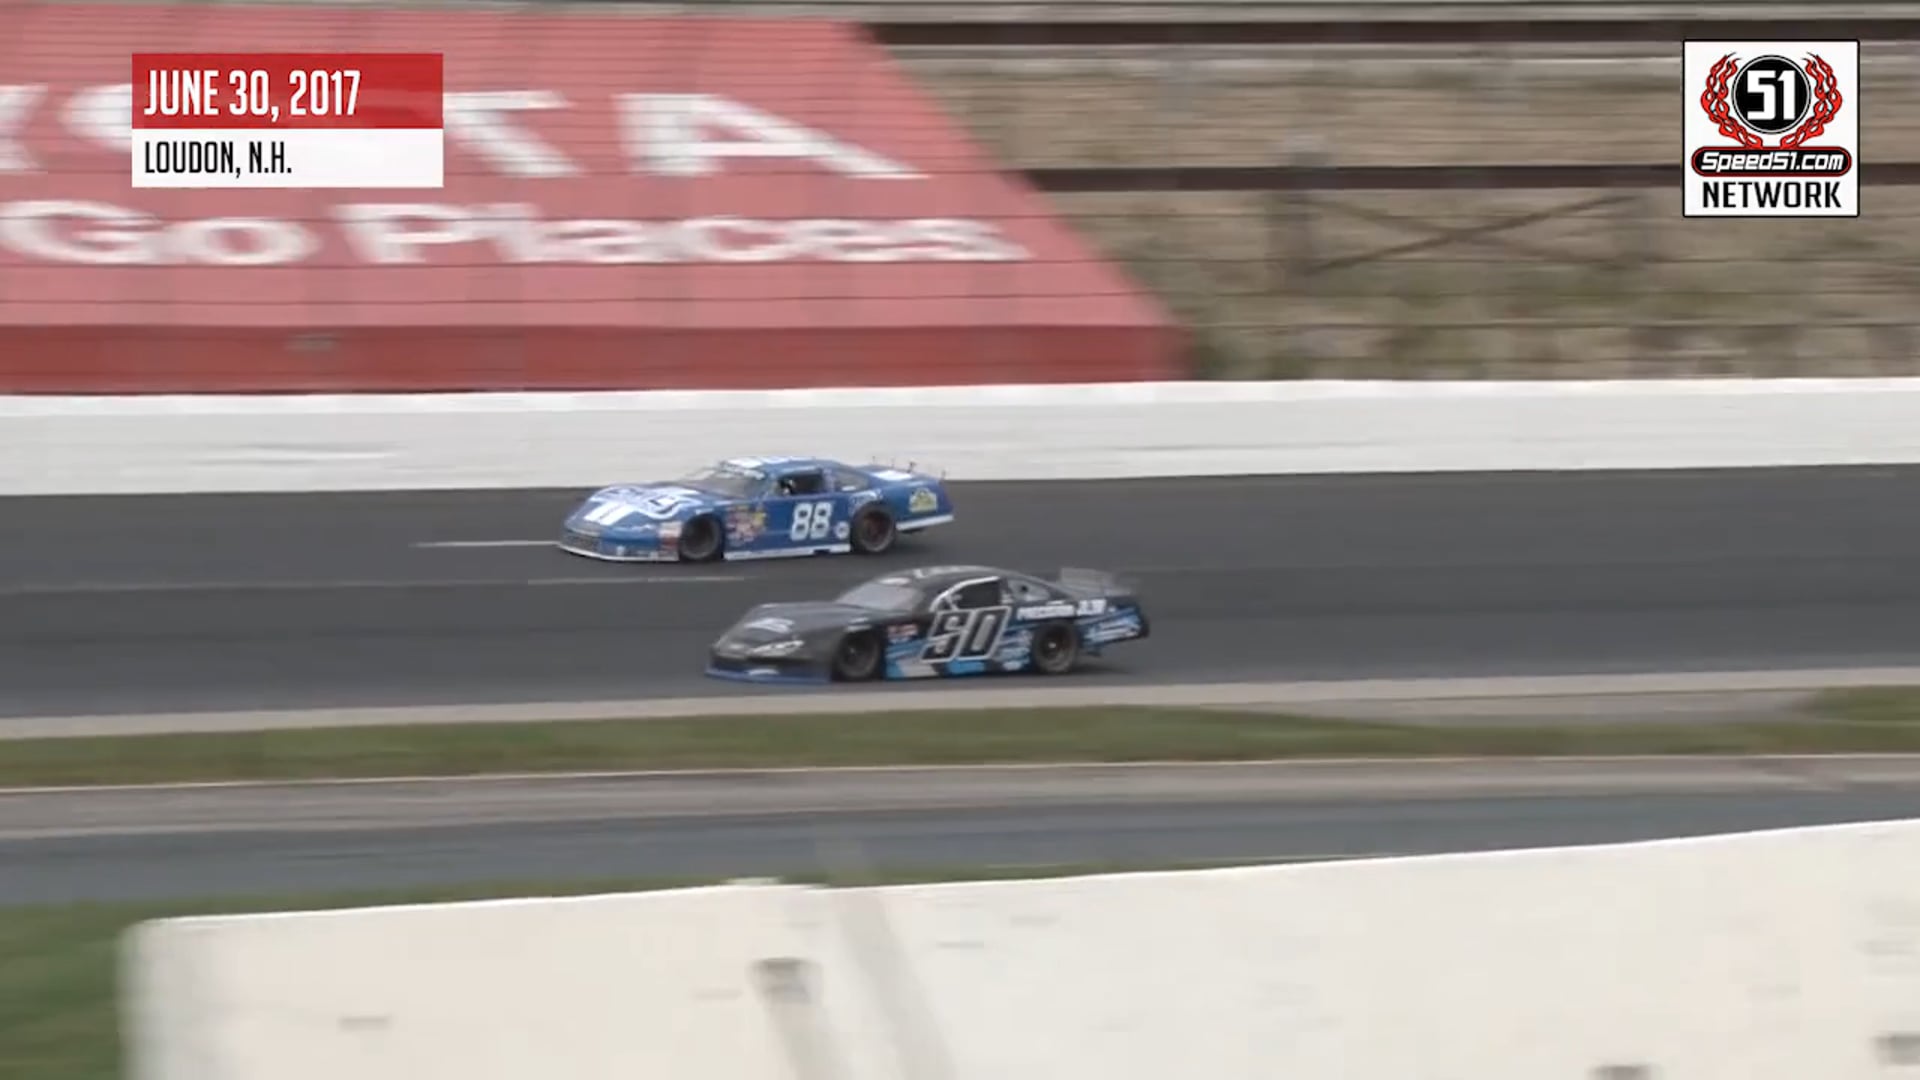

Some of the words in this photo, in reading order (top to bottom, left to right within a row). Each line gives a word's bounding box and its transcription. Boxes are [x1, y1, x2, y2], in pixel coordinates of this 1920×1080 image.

[0, 200, 314, 266] Go
[333, 202, 1030, 265] Places
[790, 502, 833, 541] 88
[922, 606, 1011, 662] 50
